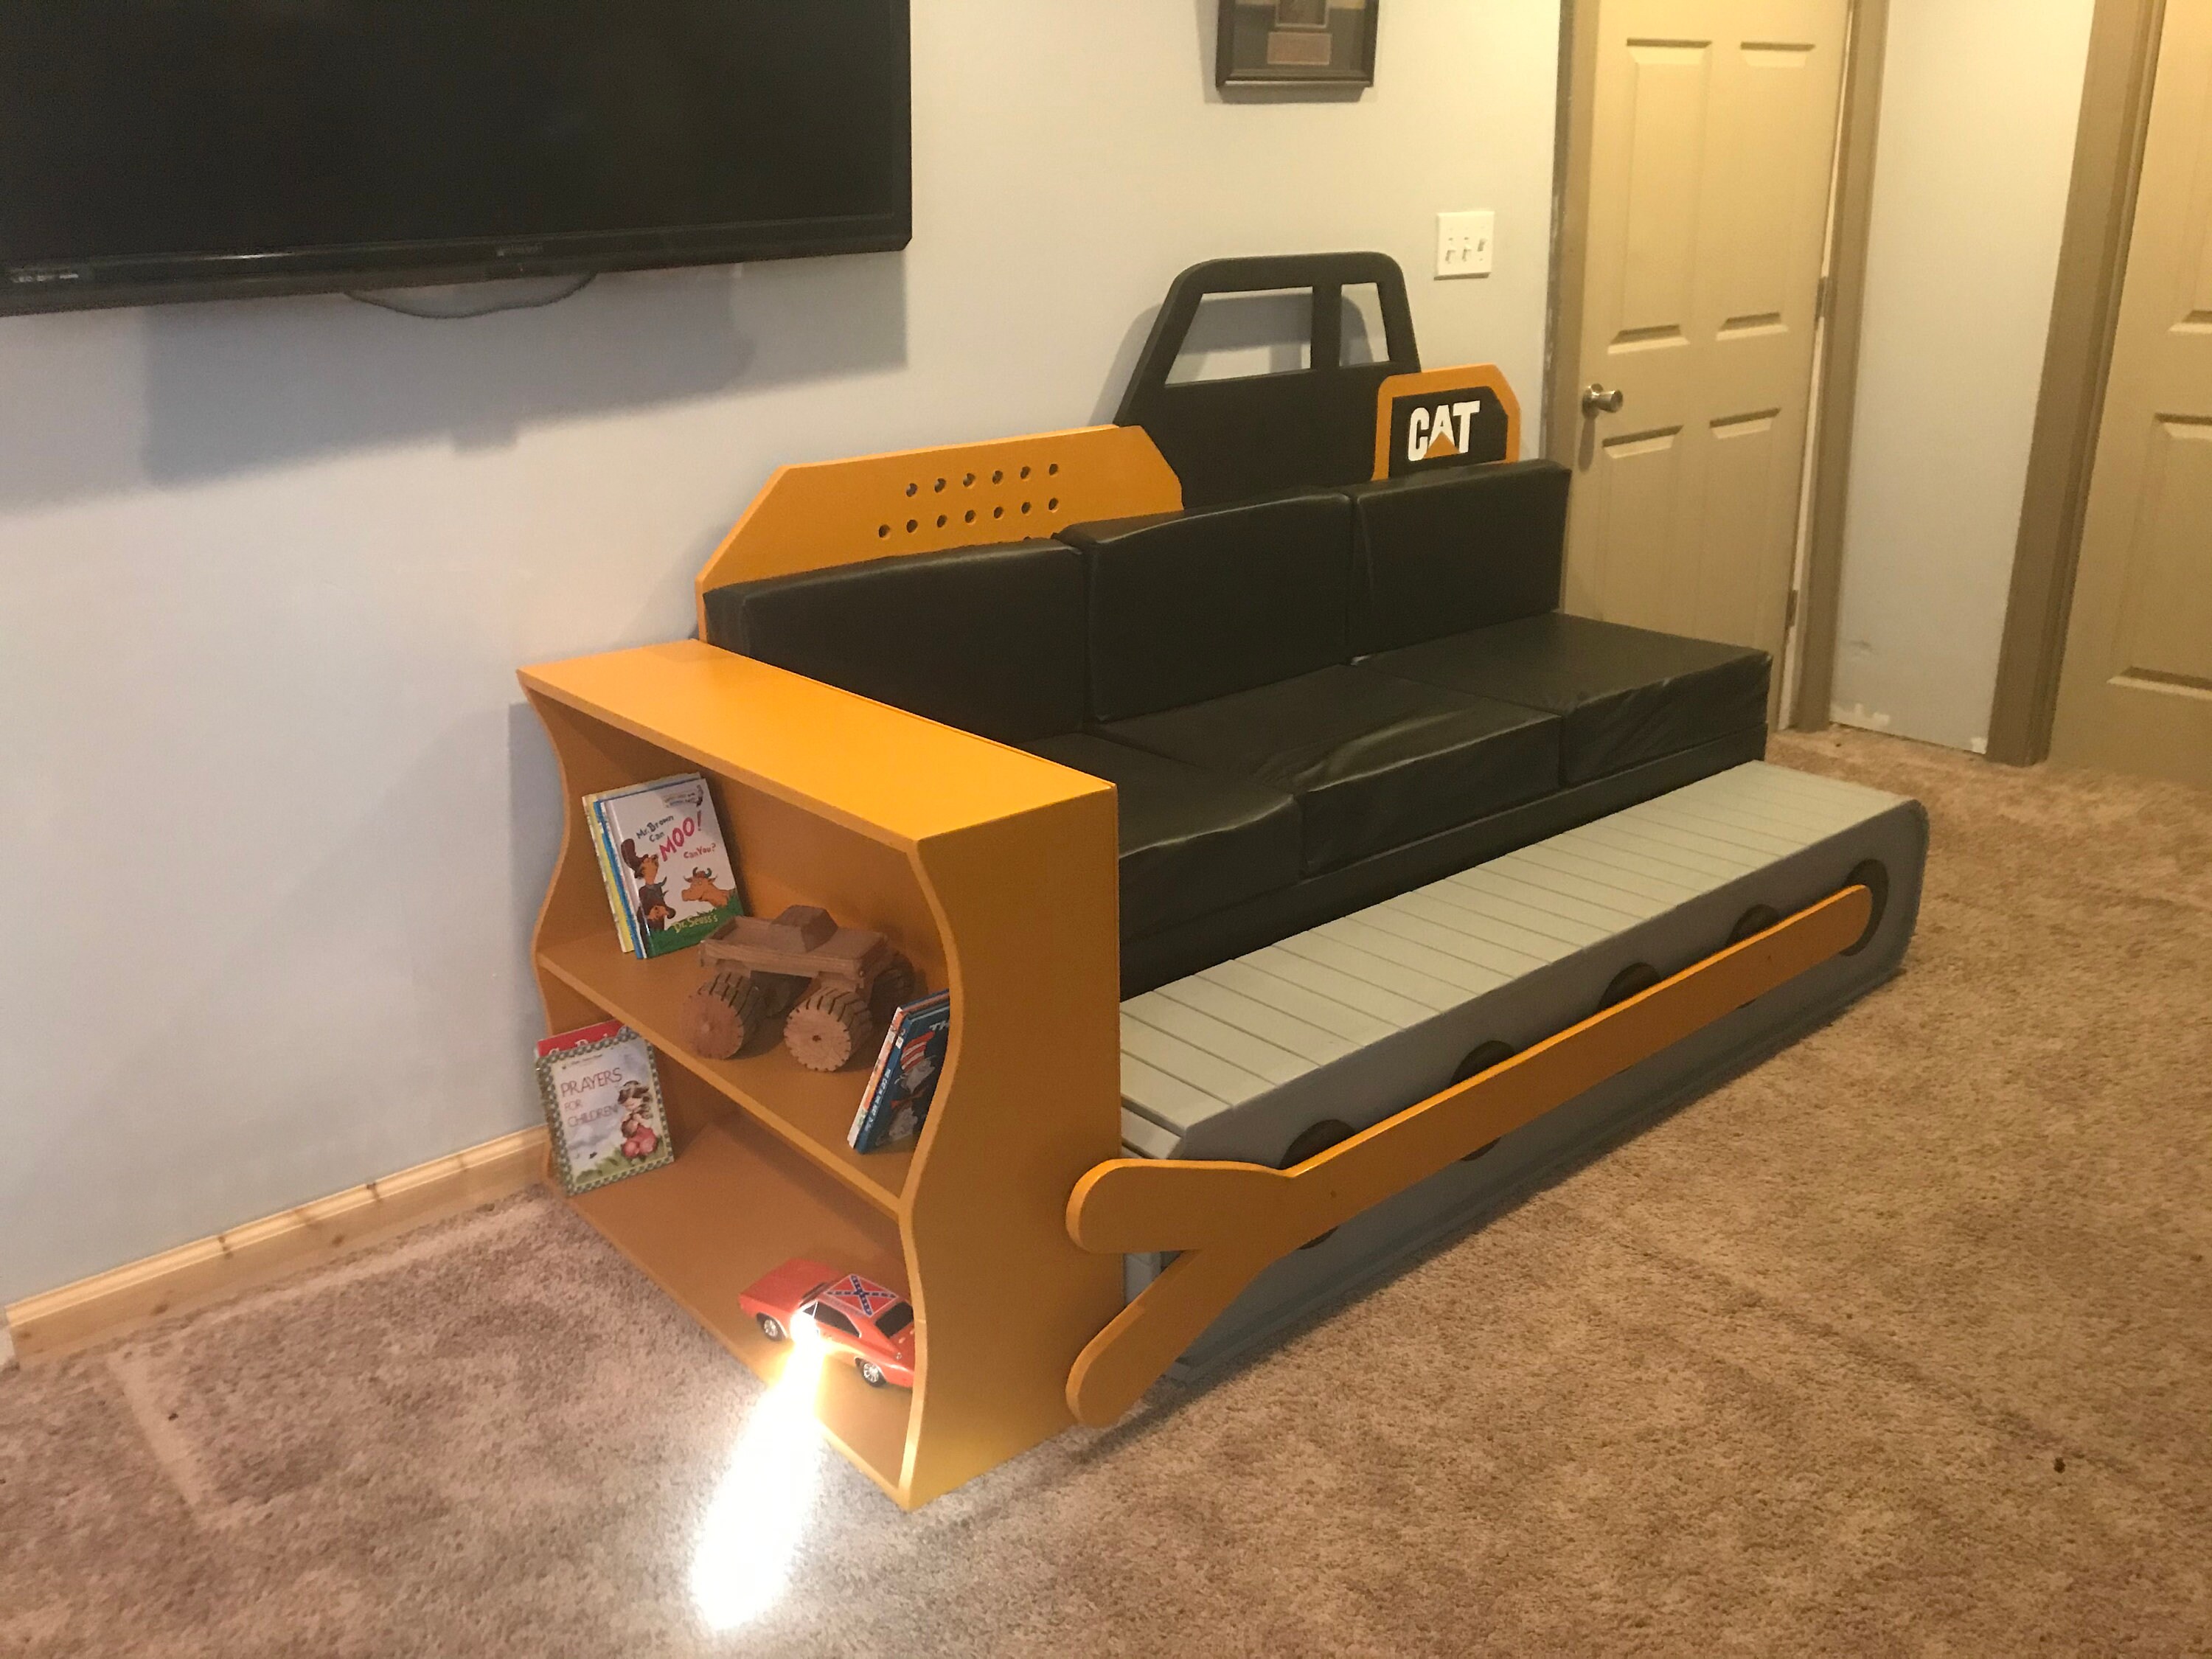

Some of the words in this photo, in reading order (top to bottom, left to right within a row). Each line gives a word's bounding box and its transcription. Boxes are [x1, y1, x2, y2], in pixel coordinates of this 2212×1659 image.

[1408, 400, 1481, 462] CAT
[648, 815, 675, 832] Brown
[649, 832, 666, 843] Can
[658, 810, 703, 862] MOO!
[673, 922, 686, 933] Dr.
[687, 914, 718, 928] Seuss's
[560, 1067, 623, 1098] PRAYERS
[563, 1099, 582, 1110] FOR
[567, 1104, 619, 1127] CHILDREN
